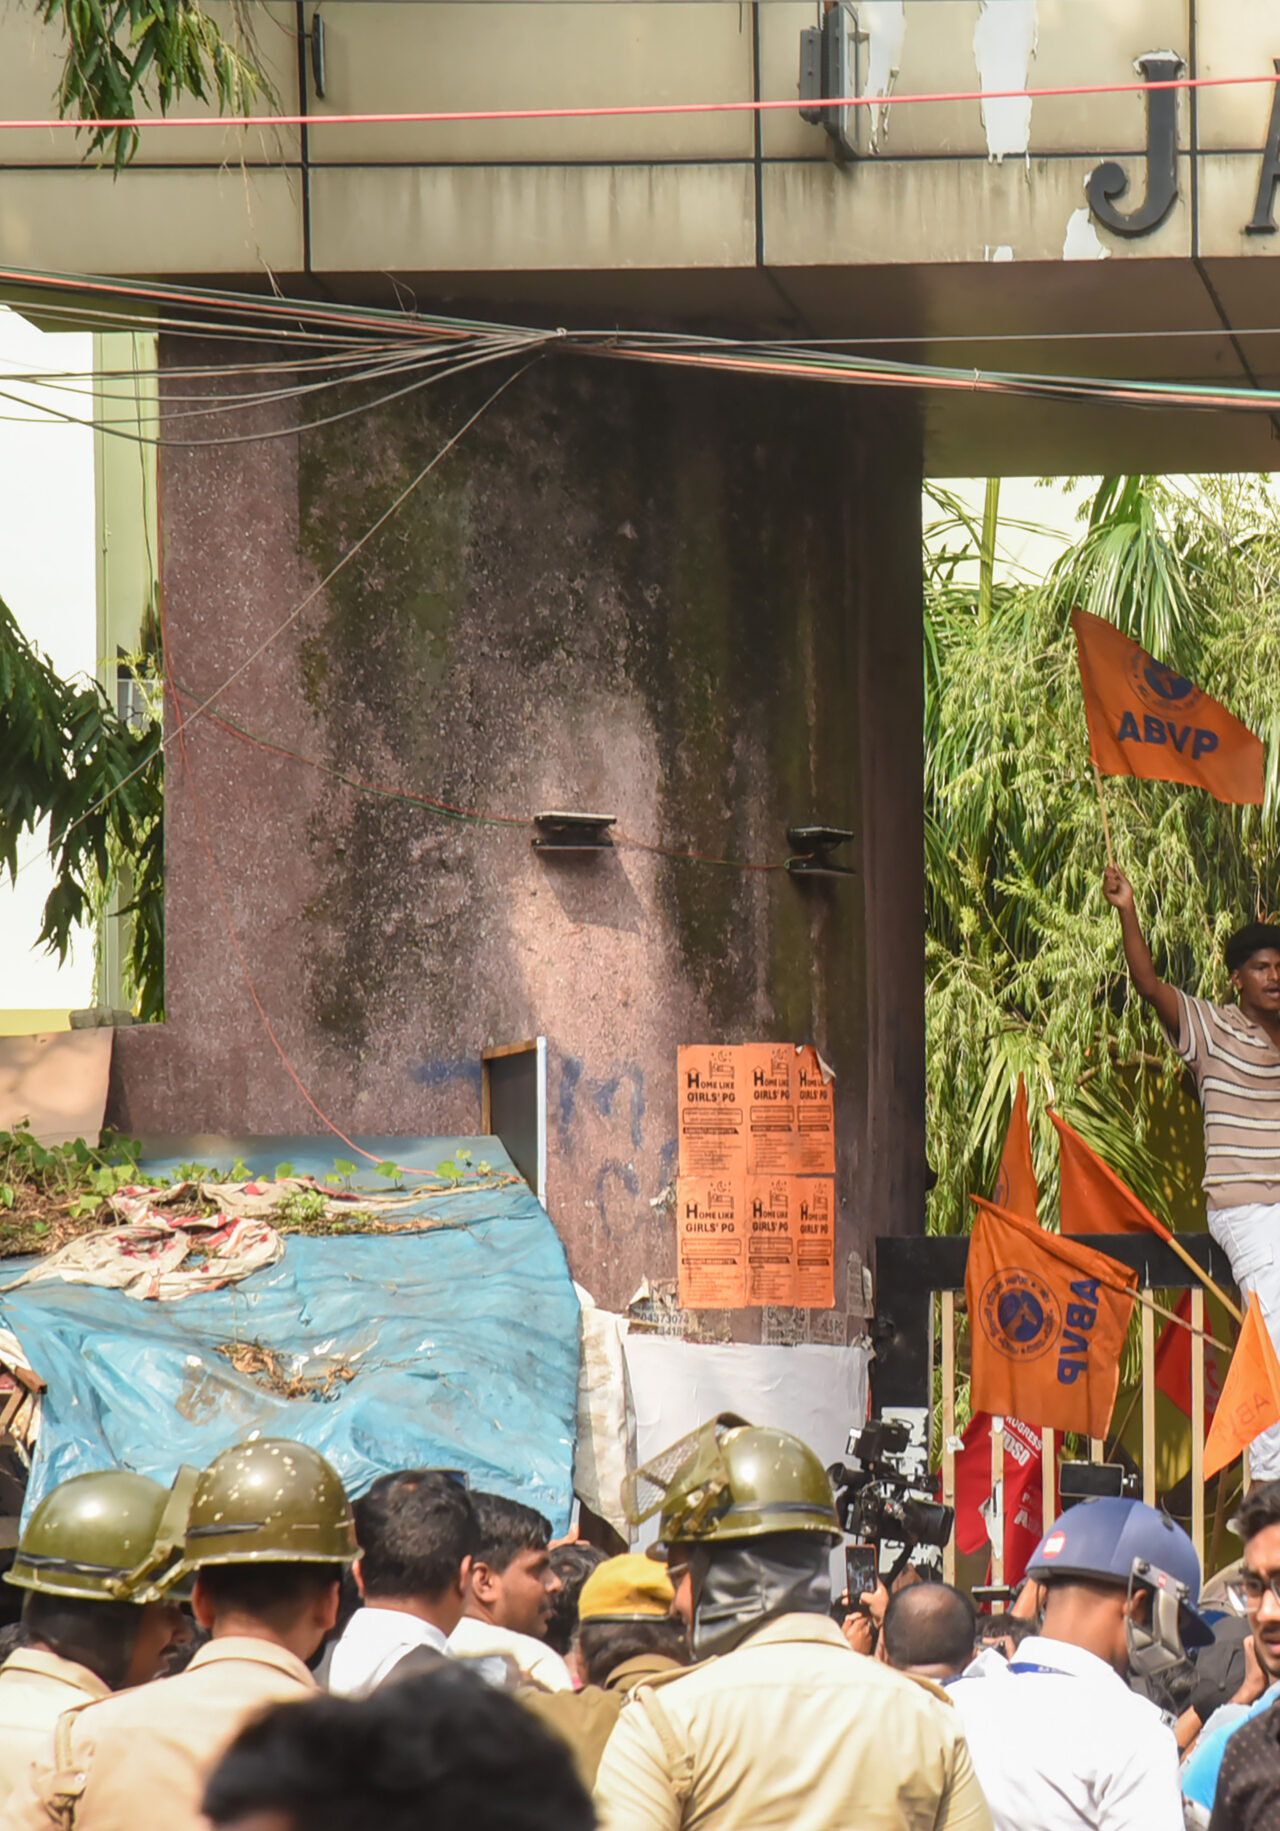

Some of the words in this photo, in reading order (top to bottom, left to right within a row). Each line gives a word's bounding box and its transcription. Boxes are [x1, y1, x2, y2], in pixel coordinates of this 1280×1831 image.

[1117, 709, 1219, 760] ABVP
[687, 1071, 717, 1089] HOME
[719, 1081, 735, 1090] LIKE
[686, 1203, 717, 1220] HOME
[718, 1211, 735, 1220] LIKE
